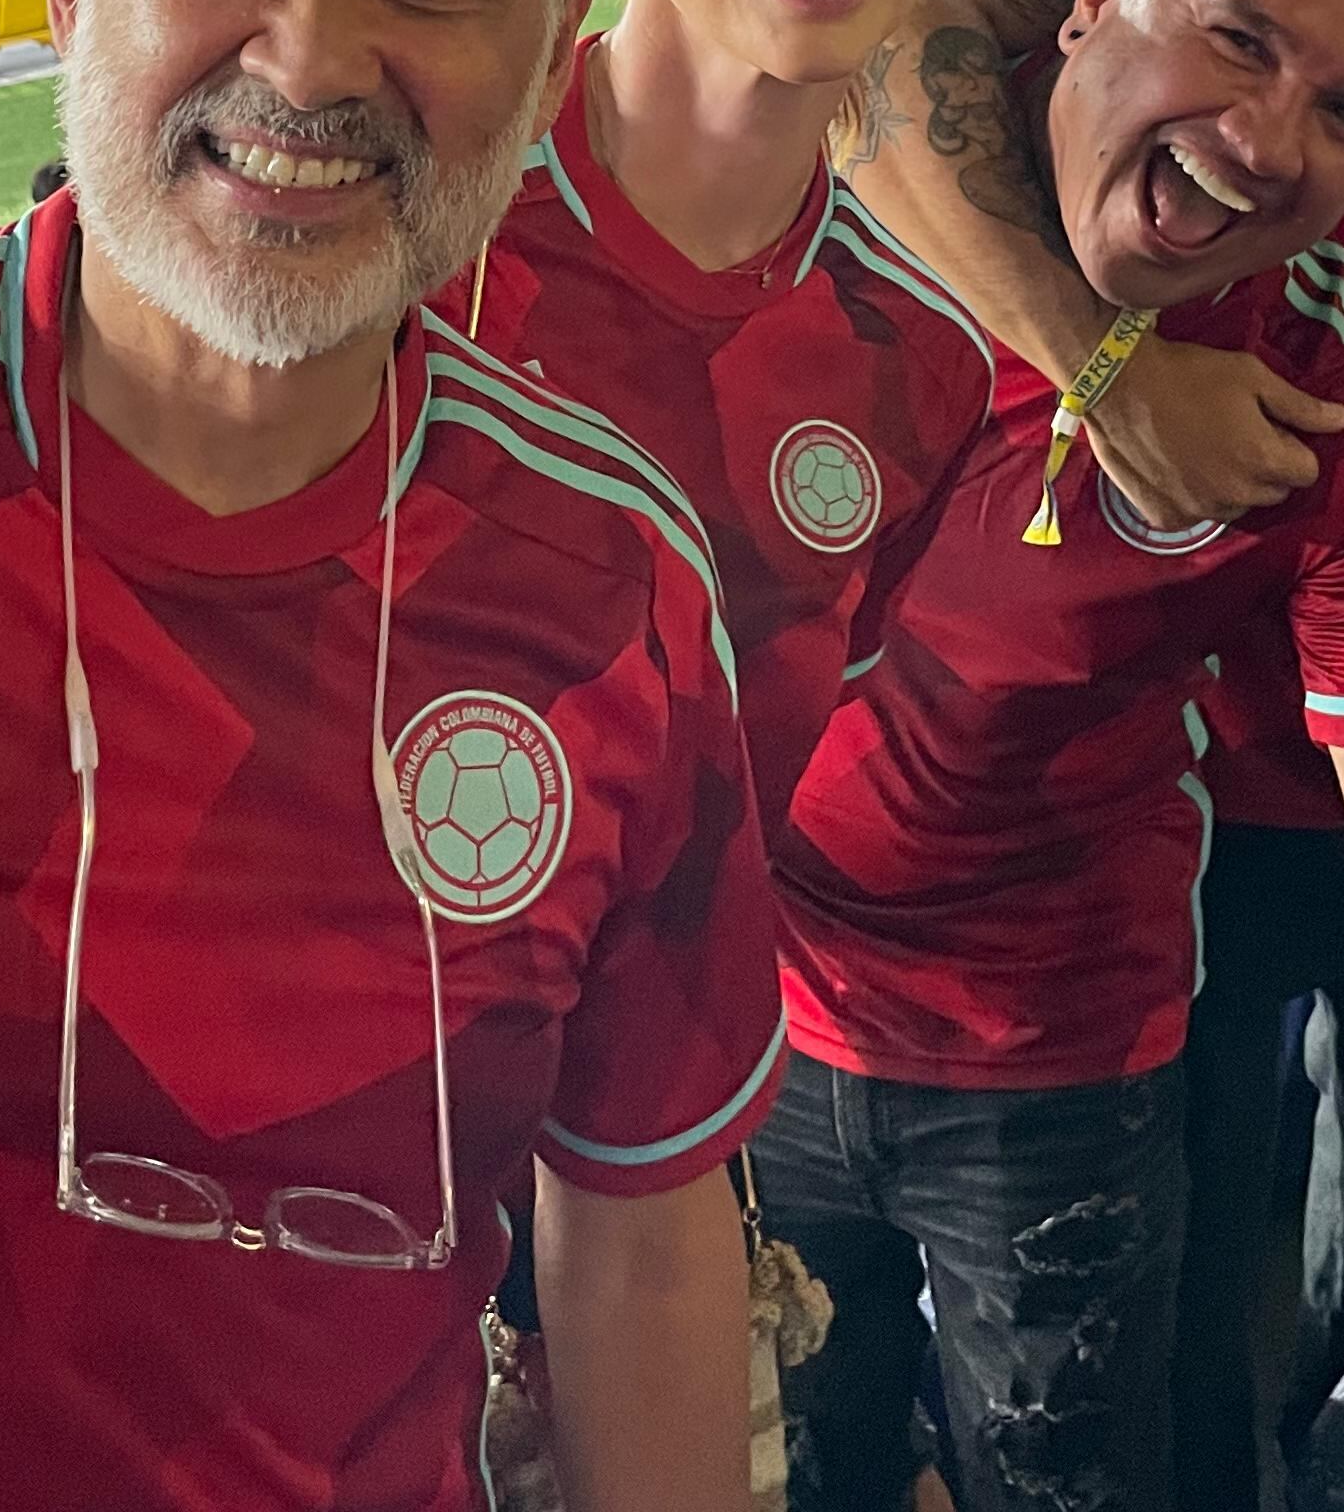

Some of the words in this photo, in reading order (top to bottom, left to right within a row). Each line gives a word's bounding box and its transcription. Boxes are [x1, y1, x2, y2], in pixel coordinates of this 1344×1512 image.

[1070, 371, 1096, 400] VIP
[439, 706, 519, 734] COLOMBIANA
[518, 726, 537, 748] DE
[531, 743, 557, 798] FUTBOL
